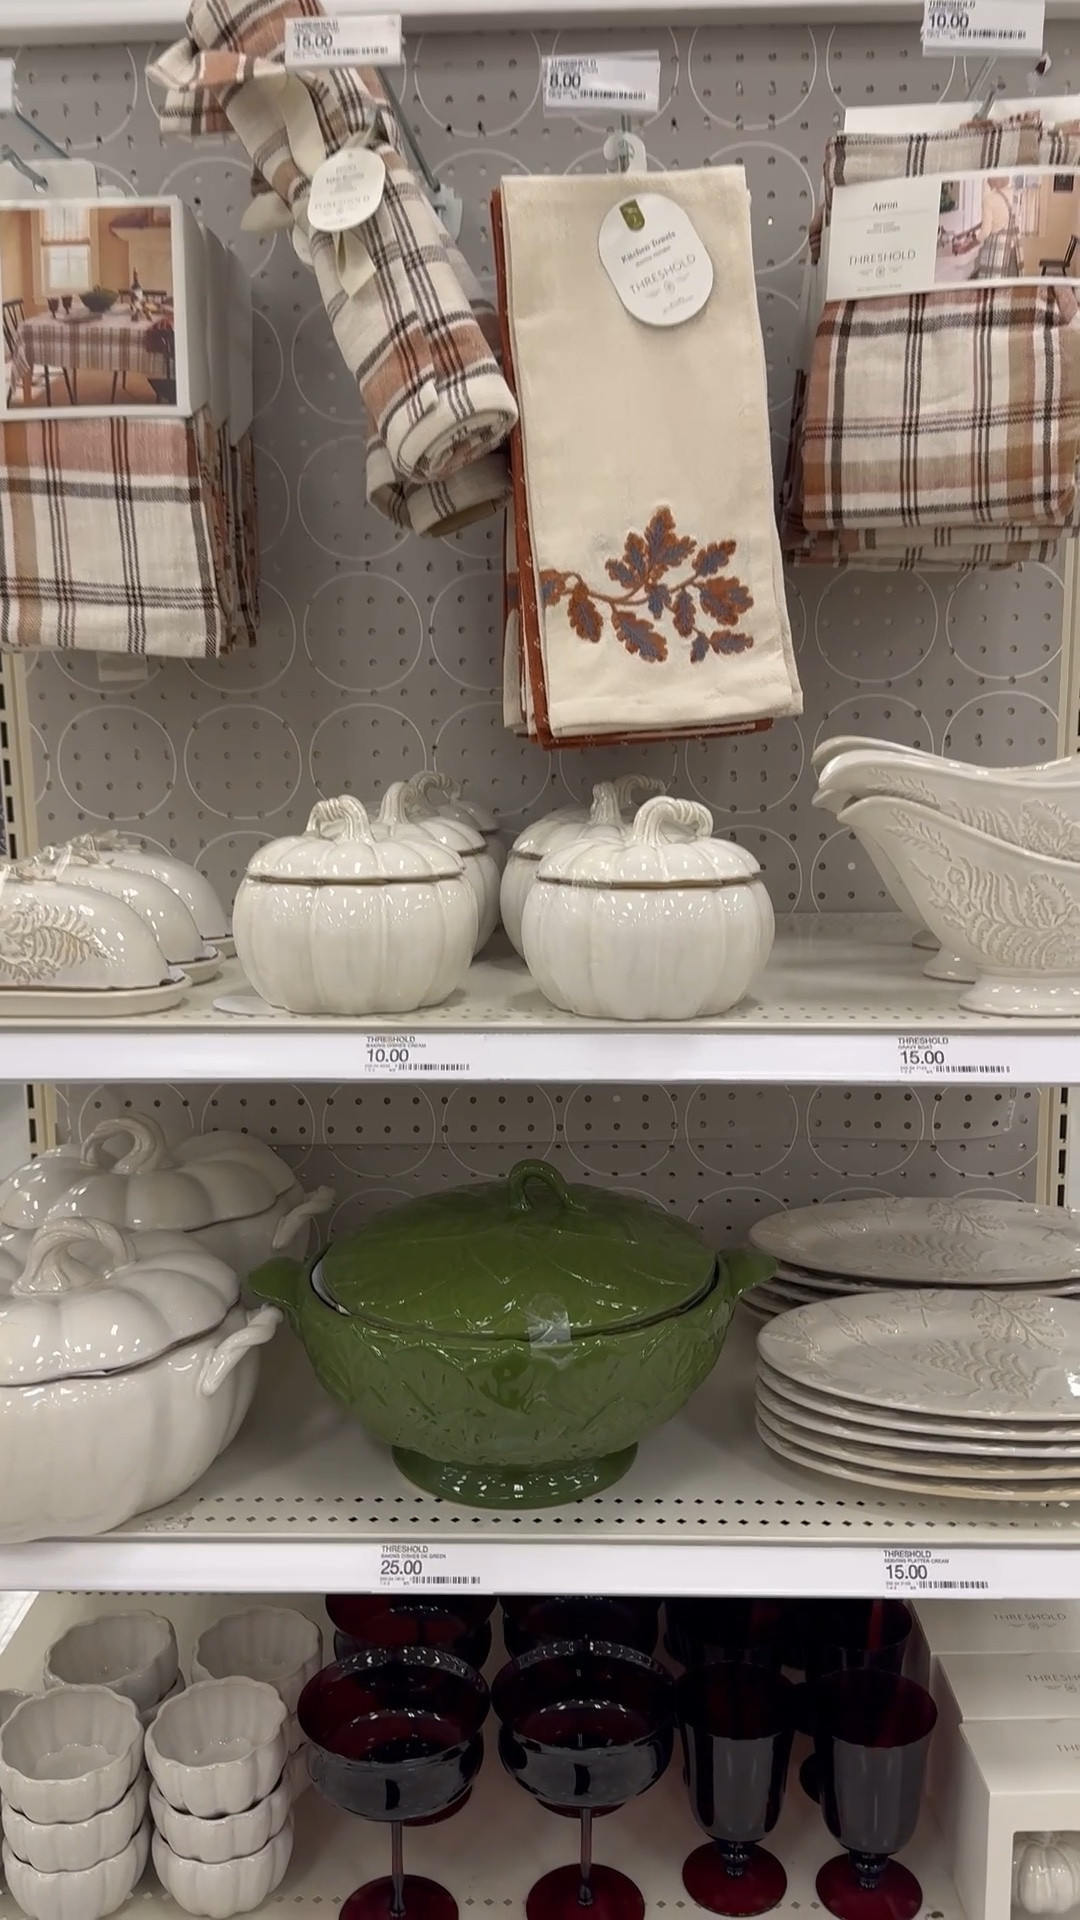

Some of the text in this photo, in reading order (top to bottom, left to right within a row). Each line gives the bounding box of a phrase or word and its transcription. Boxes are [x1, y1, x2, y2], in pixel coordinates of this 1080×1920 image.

[929, 14, 970, 29] 10.00
[294, 34, 333, 49] 15.00
[549, 73, 581, 89] 8.00
[872, 201, 898, 213] Apron
[620, 244, 652, 265] Kitchen
[849, 249, 916, 266] THRESHOLD
[629, 253, 697, 294] THRESHOLD
[366, 1035, 416, 1043] THRESHOLD
[898, 1037, 949, 1045] THRESHOLD
[367, 1048, 409, 1063] 10.00
[900, 1050, 945, 1065] 15.00
[381, 1545, 428, 1553] THRESHOLD
[883, 1550, 931, 1558] THRESHOLD
[380, 1560, 423, 1575] 25.00
[886, 1564, 928, 1580] 15.00
